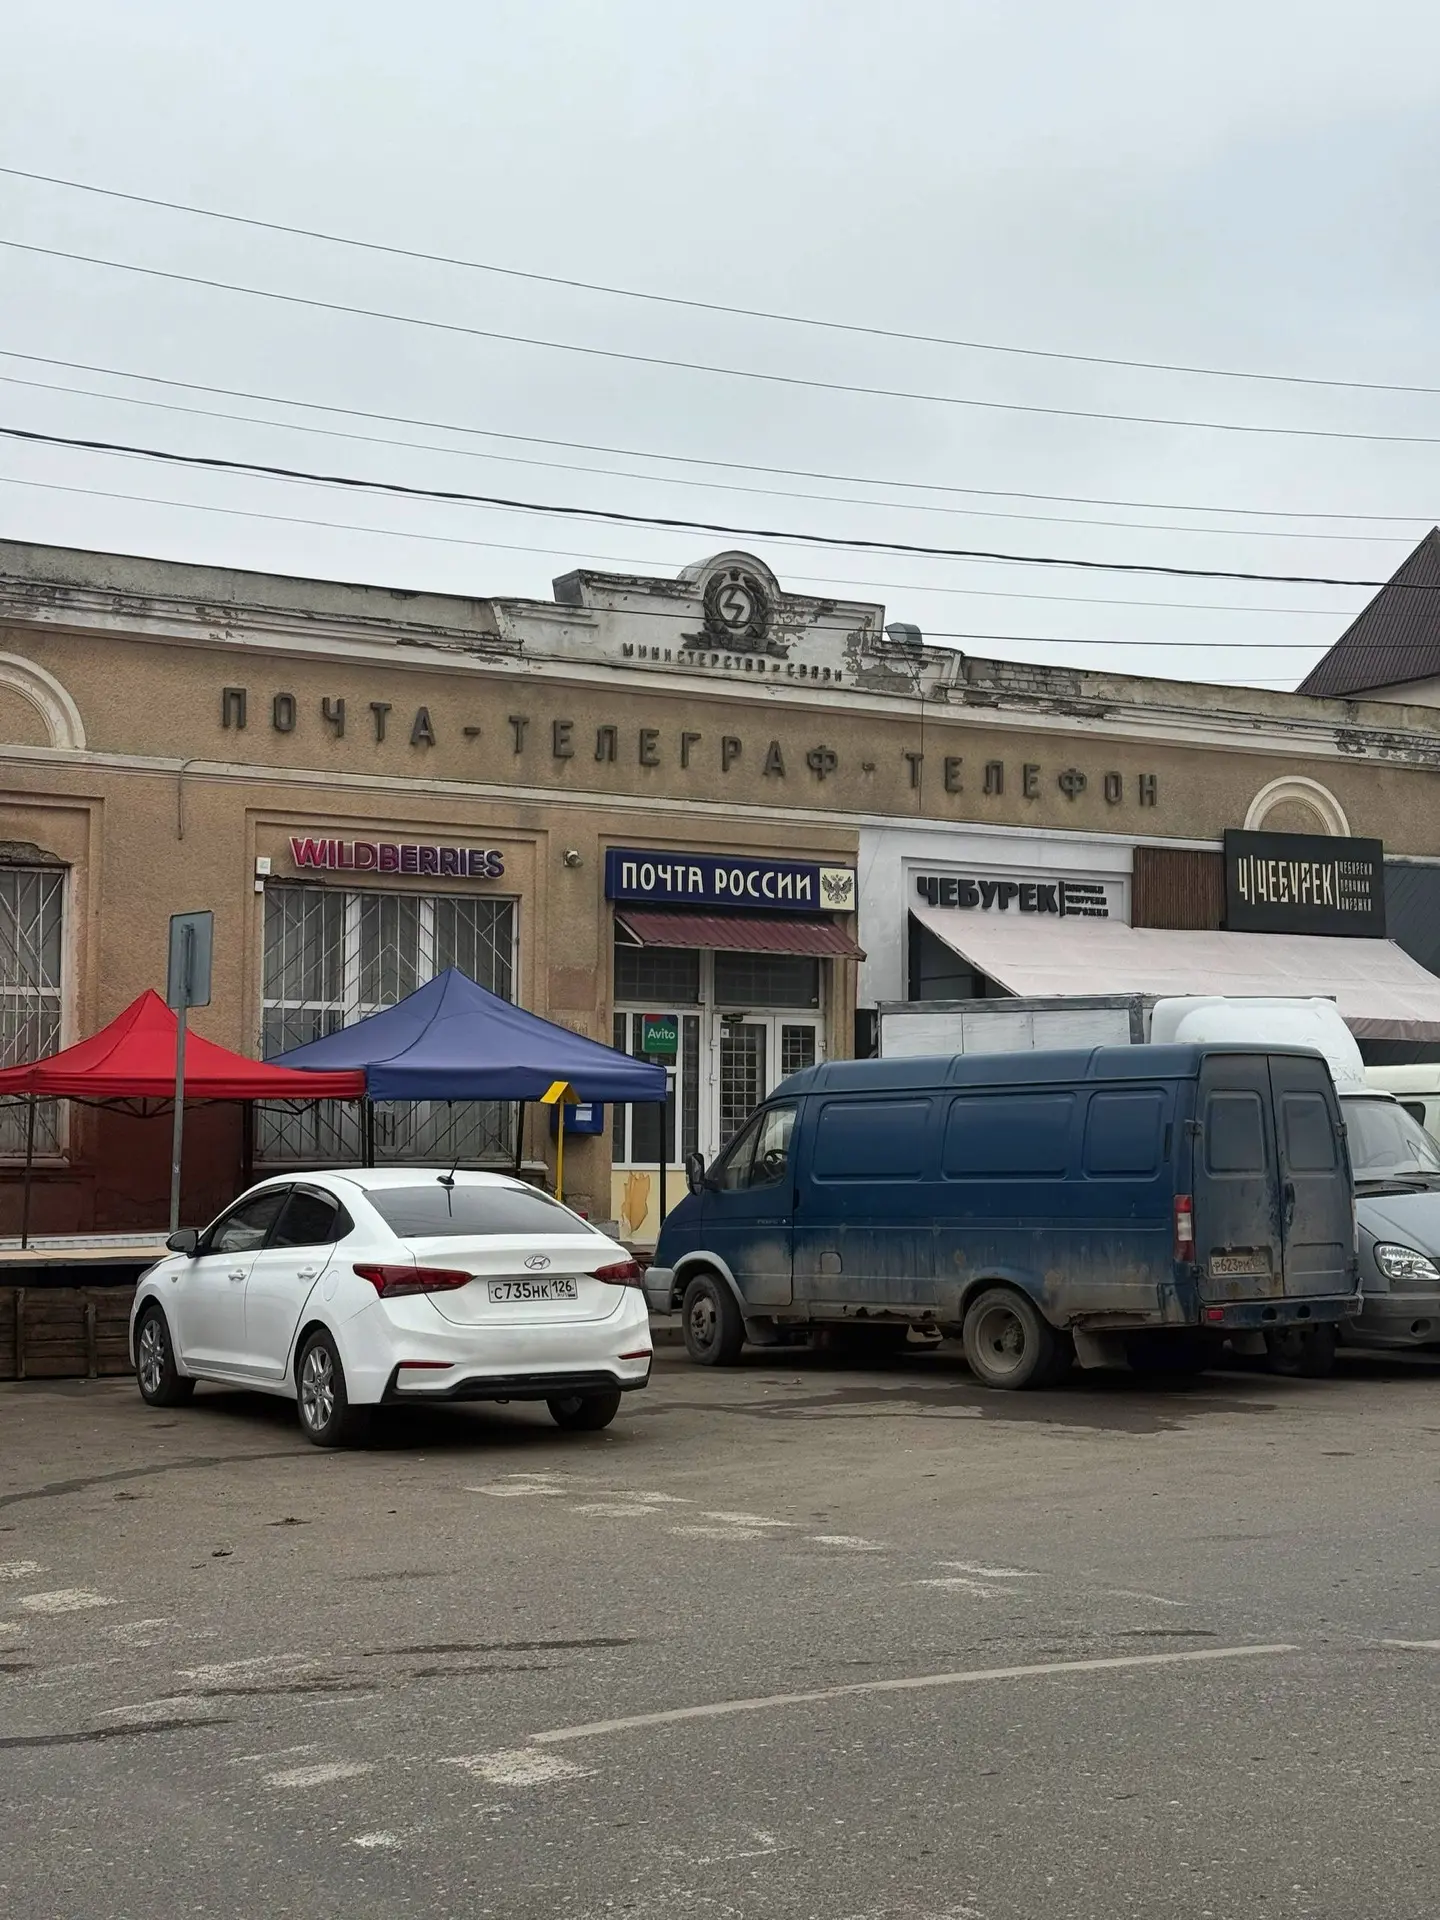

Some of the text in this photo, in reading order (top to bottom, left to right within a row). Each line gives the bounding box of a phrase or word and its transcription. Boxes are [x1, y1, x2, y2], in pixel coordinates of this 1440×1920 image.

[622, 643, 842, 682] МИНИСТЕРСТВО СВЯЗИ
[222, 687, 436, 746] ПОЧТА
[508, 714, 838, 781] ТЕЛЕГРАФ
[905, 752, 1158, 806] ТЕЛЕФОН
[289, 836, 505, 879] WILDBERRIES
[1339, 861, 1373, 876] ЧЕБУРЕКИ
[622, 862, 811, 900] ПОЧТА РОССИИ
[917, 876, 1058, 912] ЧЕБУРЕК
[647, 1027, 676, 1039] Avito
